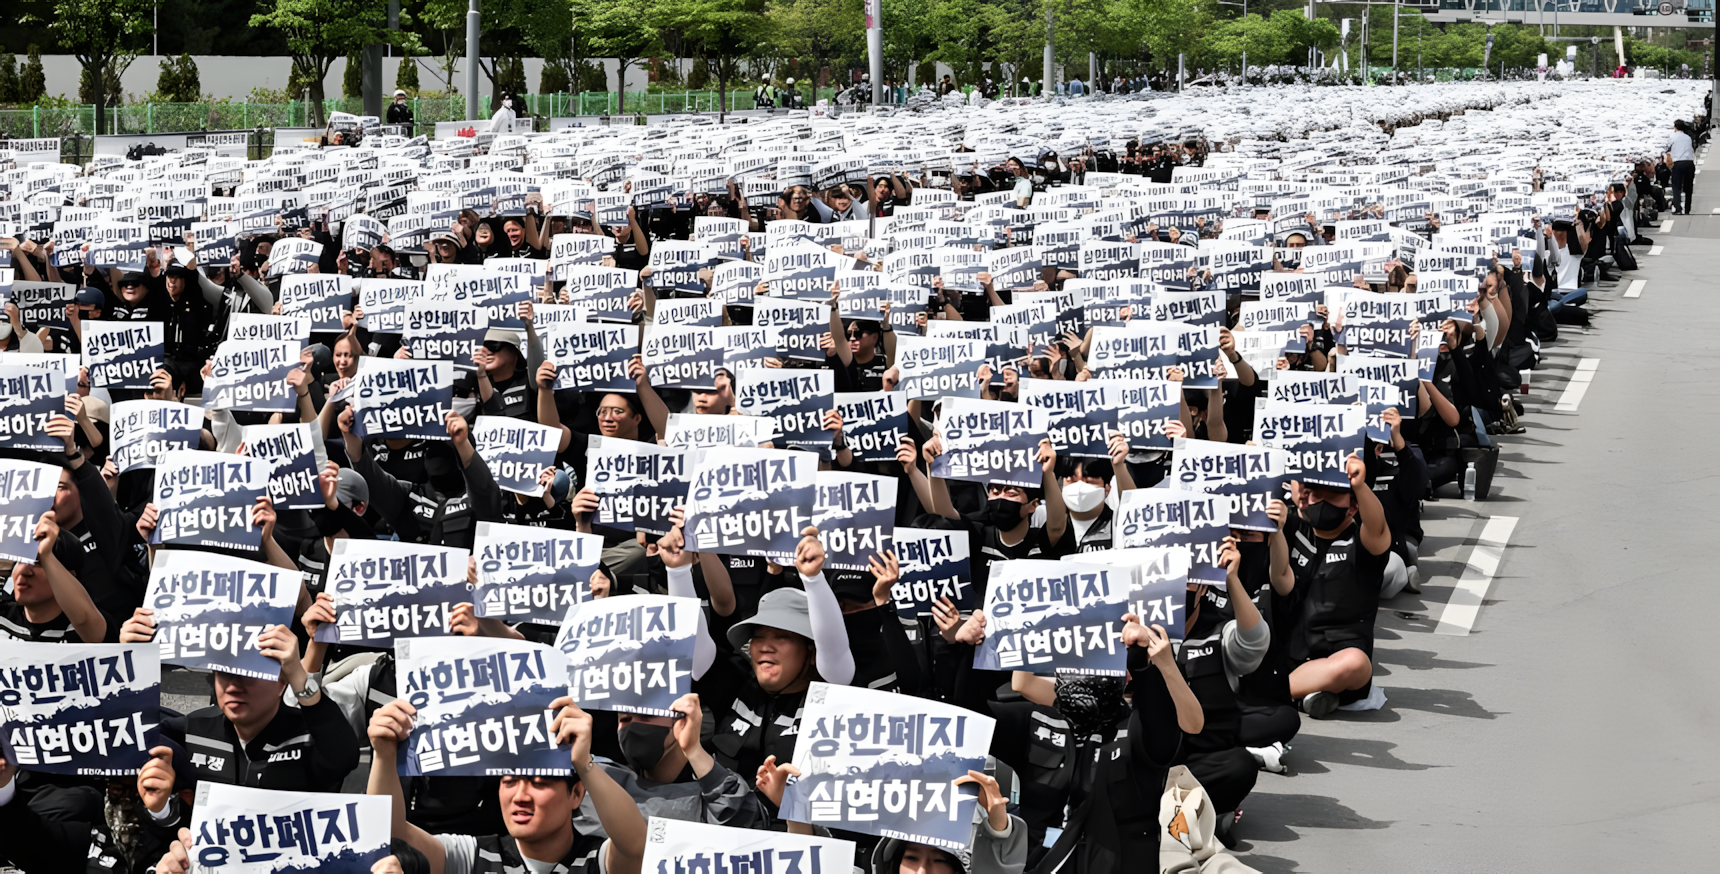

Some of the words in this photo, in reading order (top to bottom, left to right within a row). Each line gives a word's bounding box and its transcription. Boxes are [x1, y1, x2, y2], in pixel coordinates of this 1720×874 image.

[945, 409, 1033, 439] 상한폐지
[160, 461, 252, 499] 상한폐지
[695, 456, 797, 500] 상한폐지
[694, 506, 810, 549] 실현하자
[1123, 499, 1214, 536] 상한폐지
[335, 552, 448, 592] 상한폐지
[480, 537, 584, 573] 상한폐지
[154, 570, 279, 609] 상한폐지
[483, 581, 592, 616] 실현하자
[990, 570, 1110, 617] 상한폐지
[561, 602, 676, 653] 상한폐지
[996, 621, 1123, 668] 실현하자
[0, 650, 135, 706] 상한폐지
[405, 650, 546, 709] 상한폐지
[10, 711, 160, 765] 실현하자
[808, 713, 968, 757] 상한폐지
[808, 779, 978, 822] 실현하자
[195, 802, 358, 866] 상한폐지
